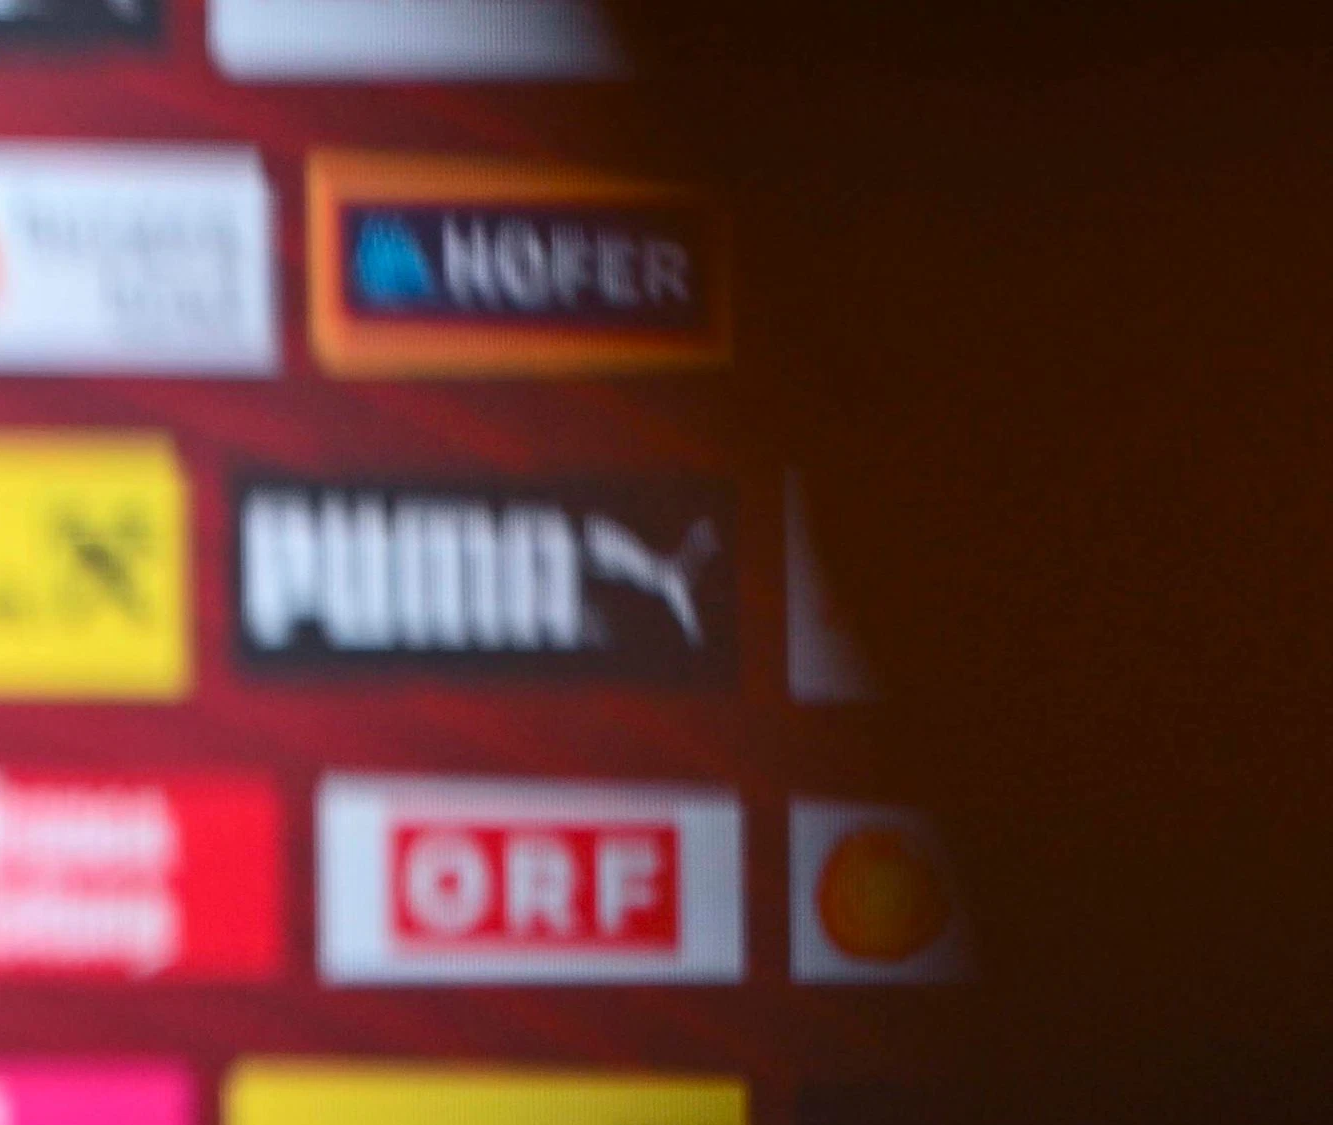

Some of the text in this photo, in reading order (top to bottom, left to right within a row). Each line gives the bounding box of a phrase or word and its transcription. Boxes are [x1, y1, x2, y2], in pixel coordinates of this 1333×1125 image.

[441, 212, 691, 310] HOFER
[239, 490, 588, 652] PUMA
[403, 832, 663, 940] ORF
